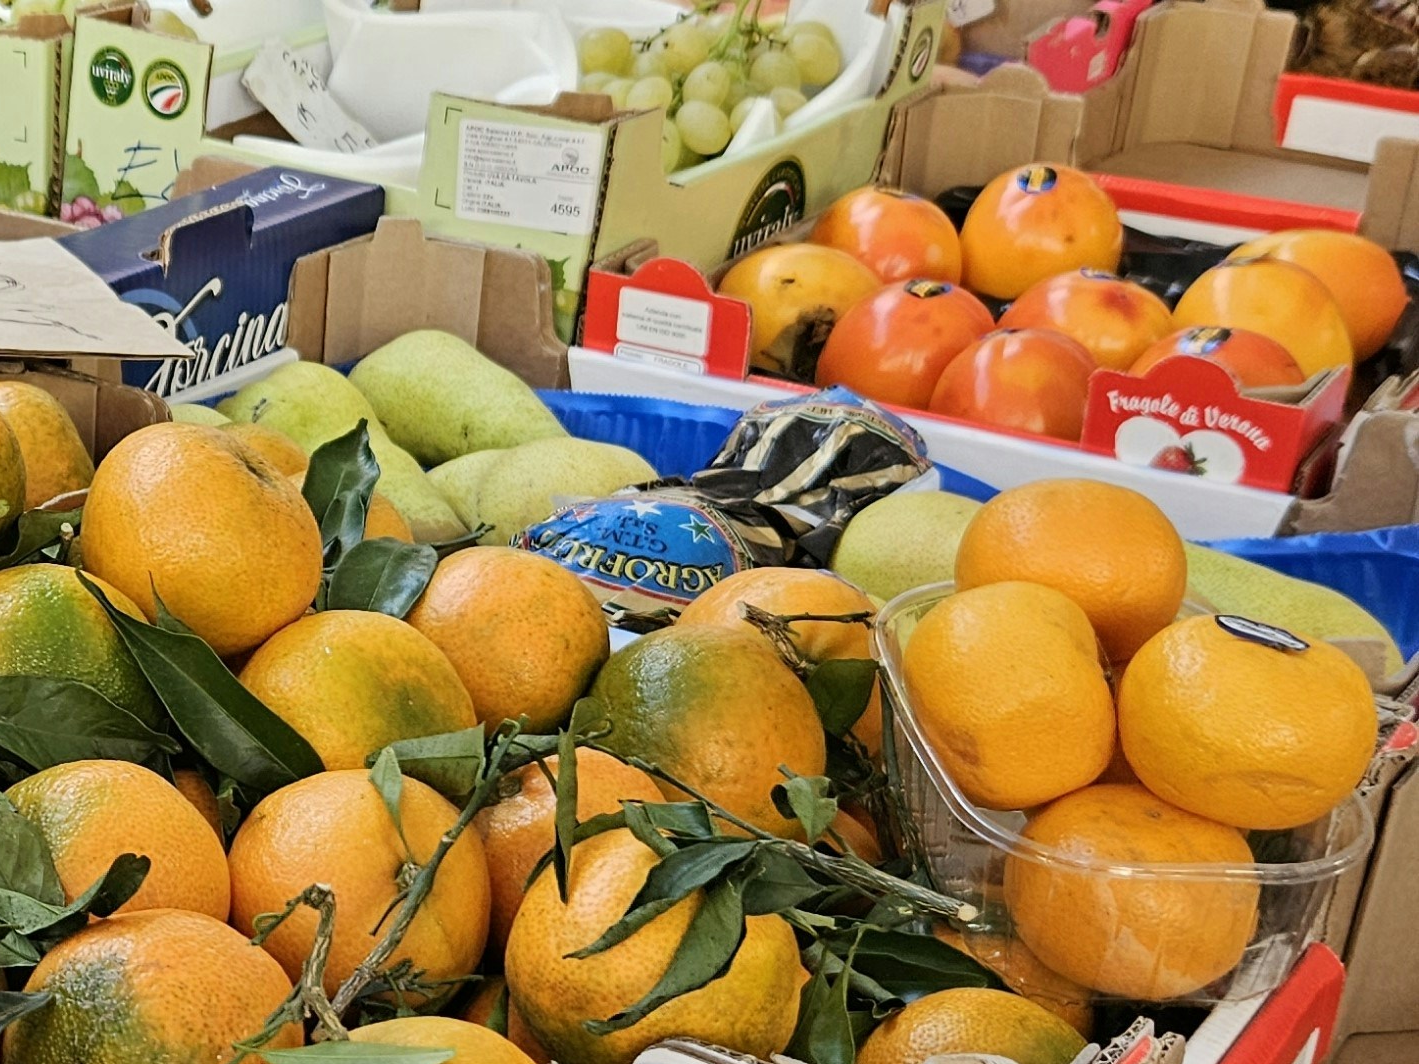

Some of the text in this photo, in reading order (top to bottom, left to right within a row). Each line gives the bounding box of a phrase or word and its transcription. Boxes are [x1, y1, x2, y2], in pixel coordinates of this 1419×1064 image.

[550, 202, 581, 218] 4595
[1106, 389, 1272, 452] Fragole di Verona
